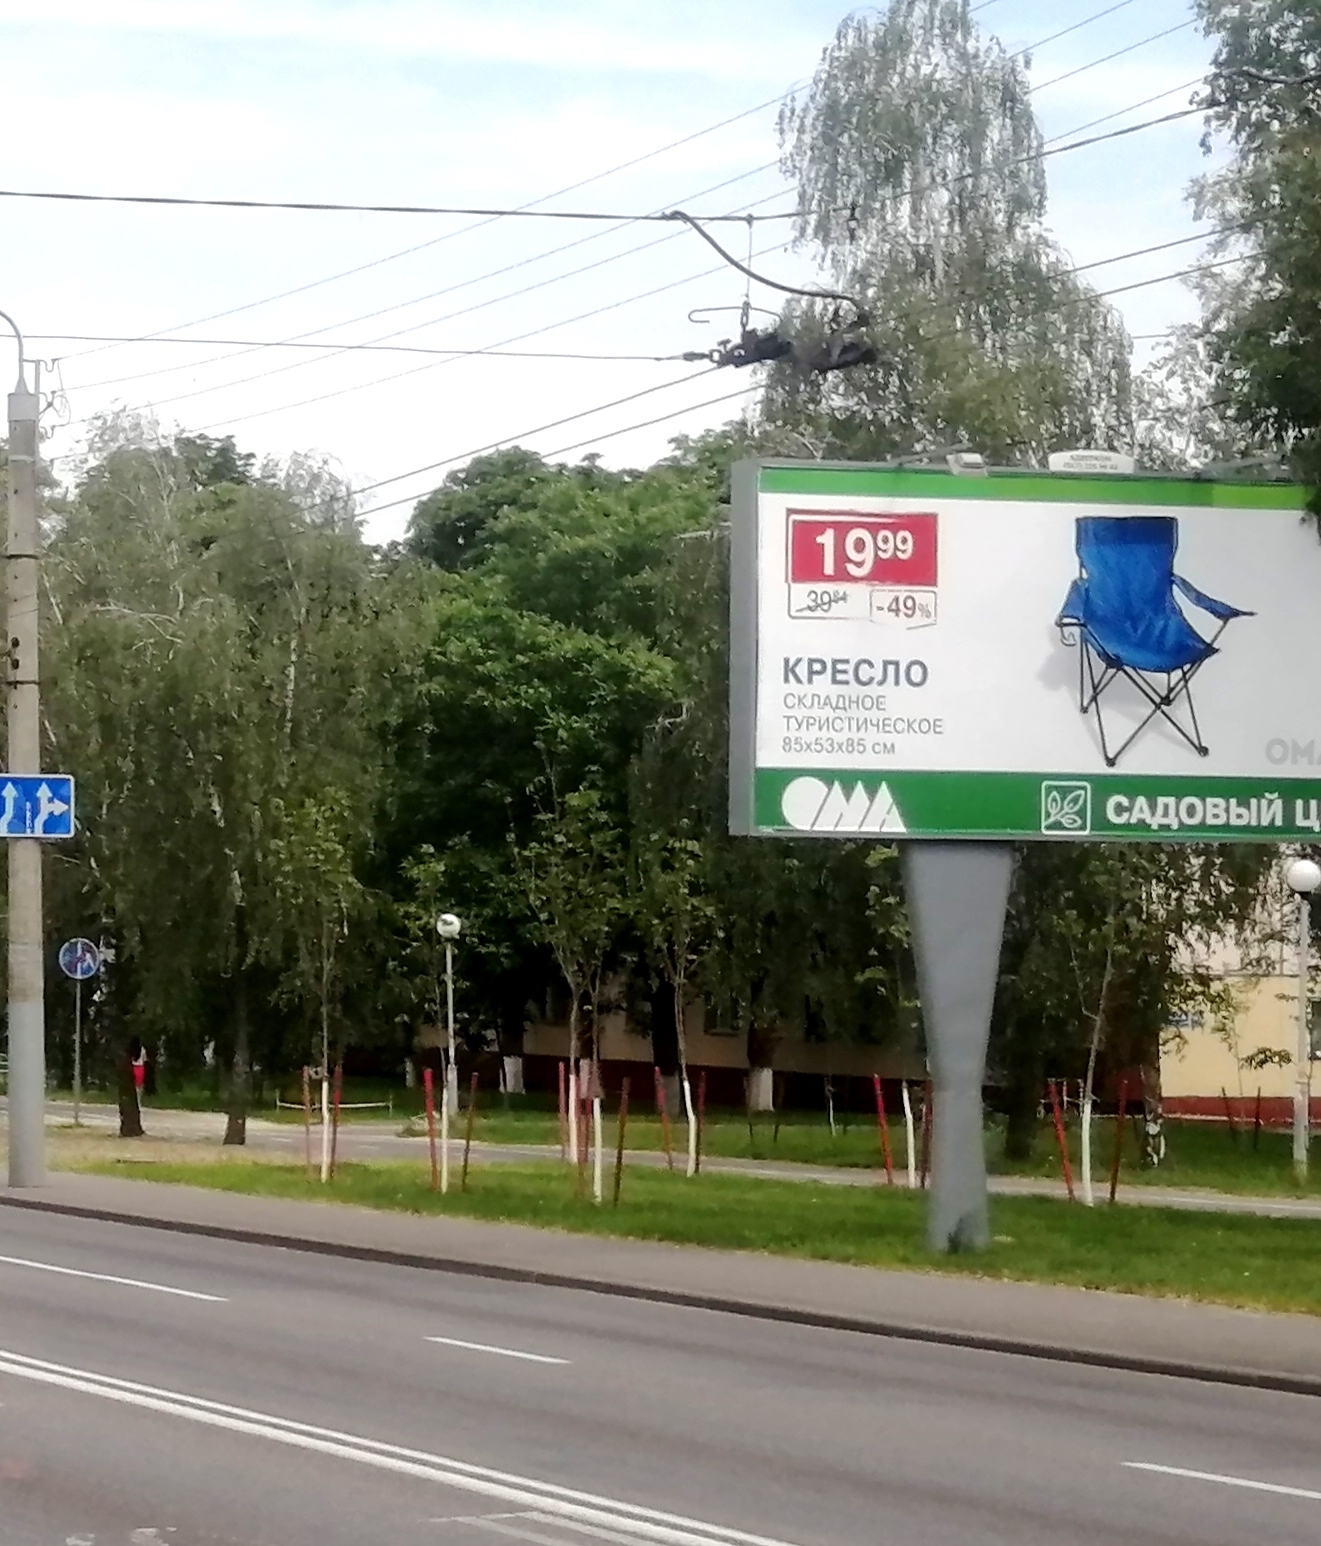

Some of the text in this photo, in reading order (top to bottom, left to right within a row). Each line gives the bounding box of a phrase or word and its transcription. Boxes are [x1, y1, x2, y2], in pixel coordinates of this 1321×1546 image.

[782, 656, 929, 688] КРЕСЛО
[783, 692, 887, 712] СКЛАДНОЕ
[782, 714, 944, 735] ТУРИСТИЧЕСКОЕ
[871, 742, 896, 755] см
[1106, 792, 1283, 831] САДОВЫЙ
